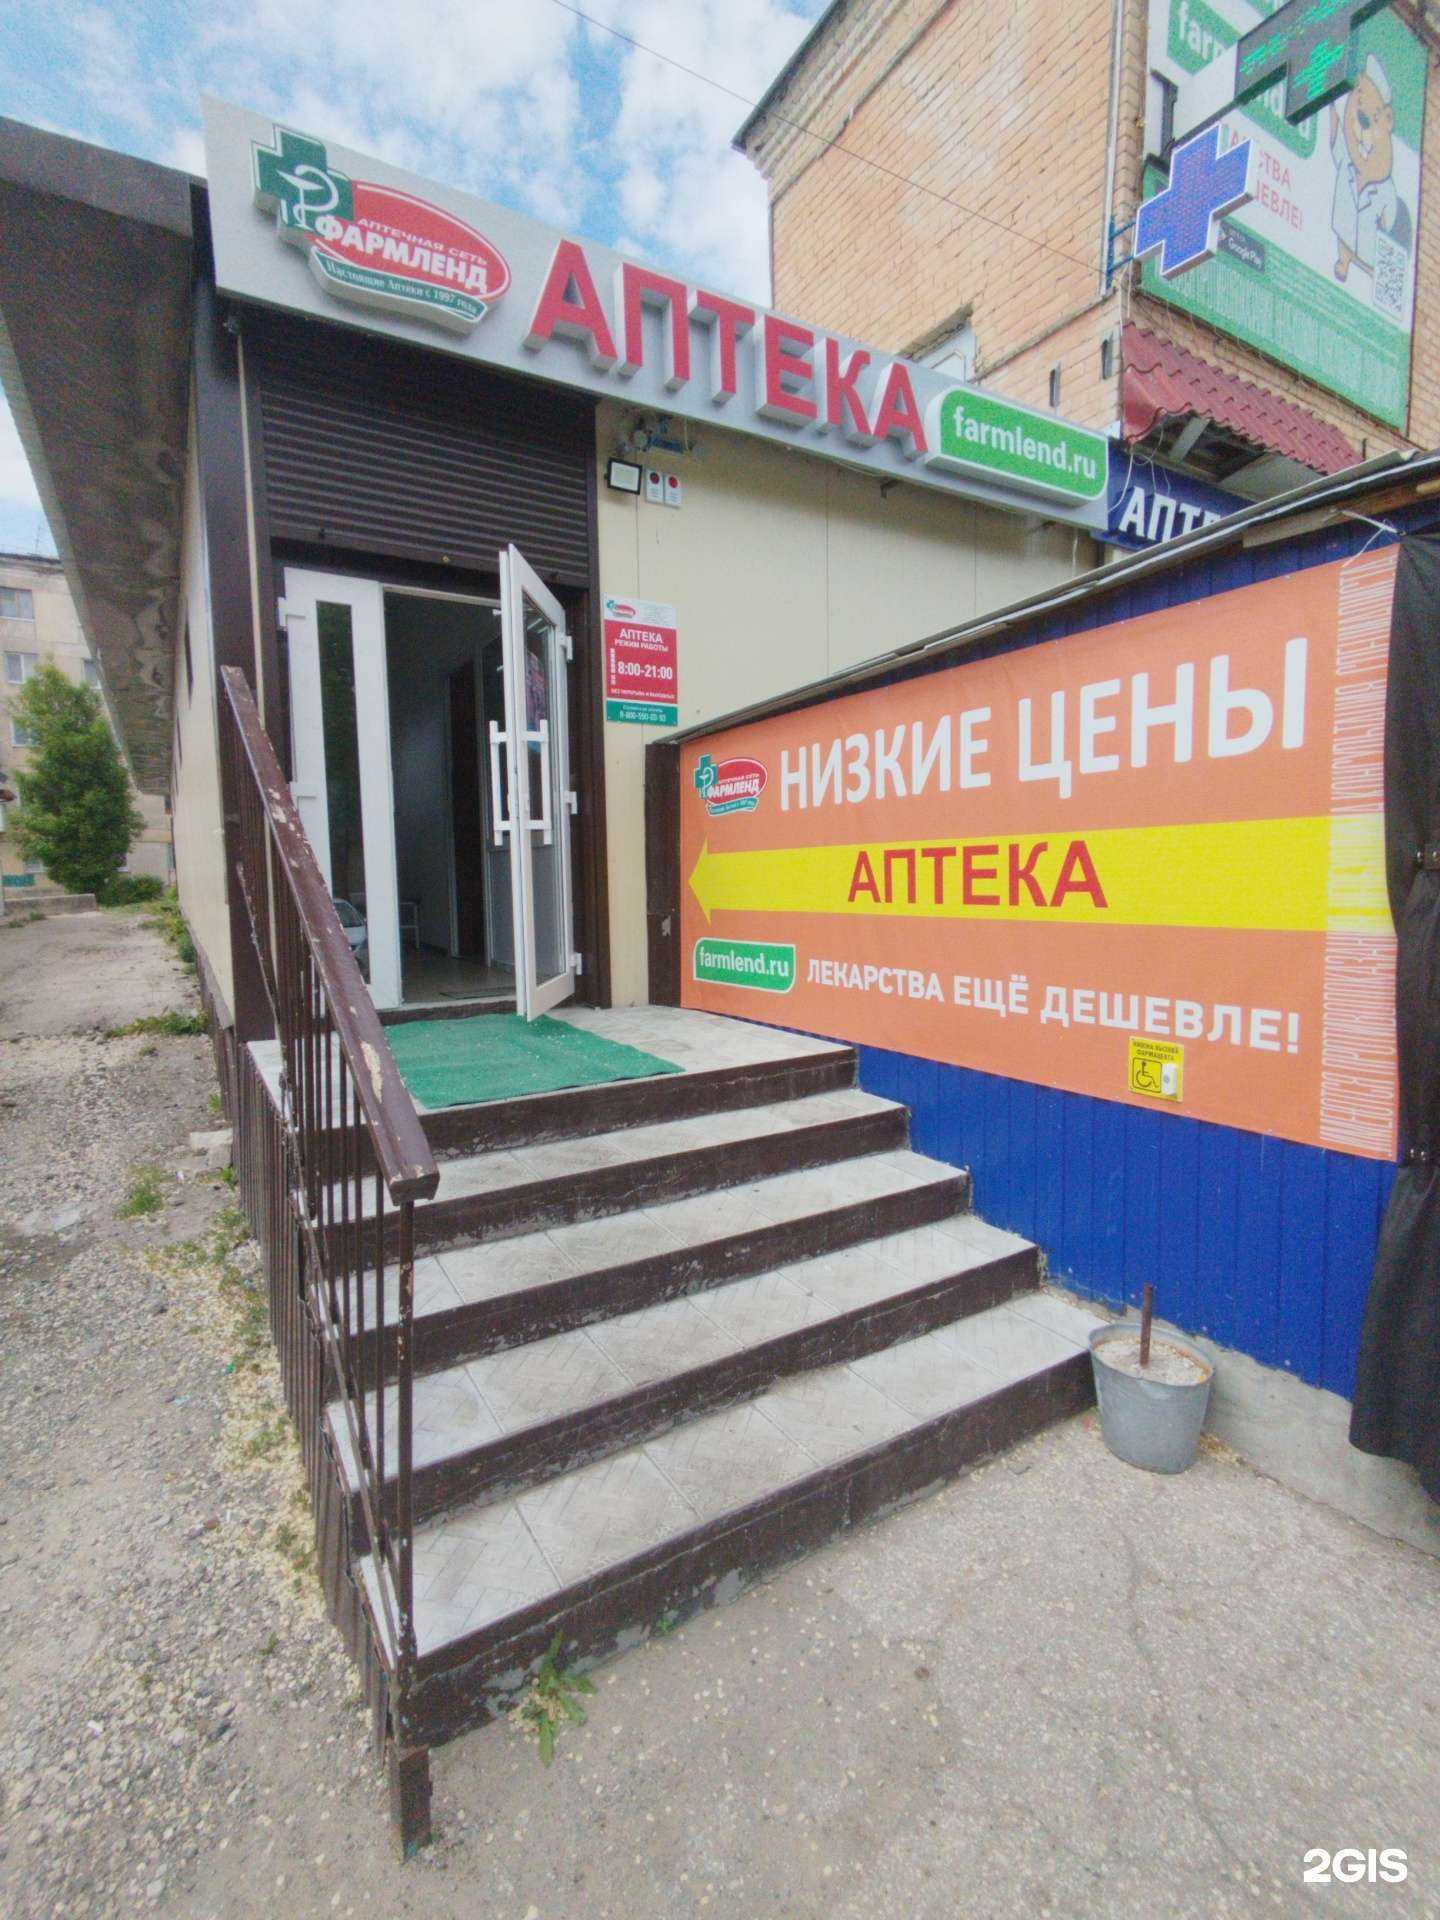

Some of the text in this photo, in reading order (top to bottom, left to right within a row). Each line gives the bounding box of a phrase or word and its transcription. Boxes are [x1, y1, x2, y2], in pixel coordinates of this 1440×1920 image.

[315, 214, 488, 294] ФАРМЛЕНД
[358, 218, 488, 265] АПТЕЧНАЯ СЕТЬ
[434, 289, 455, 303] 1997
[527, 238, 930, 456] АПТЕКА
[953, 406, 1096, 480] farmlend.ru
[614, 639, 669, 652] РЕЖИМ РАБОТЫ
[620, 628, 664, 644] АПТЕКА
[618, 660, 673, 680] 8:00-21:00
[780, 637, 1308, 812] НИЗКИЕ ЦЕНЫ
[707, 778, 760, 799] ФАРМЛЕНД
[847, 839, 1108, 909] АПТЕКА
[699, 946, 789, 977] farmlend.ru
[807, 958, 1299, 1055] ЛЕКАРСТВА ЕЩЁ ДЕШЕВЛЕ!
